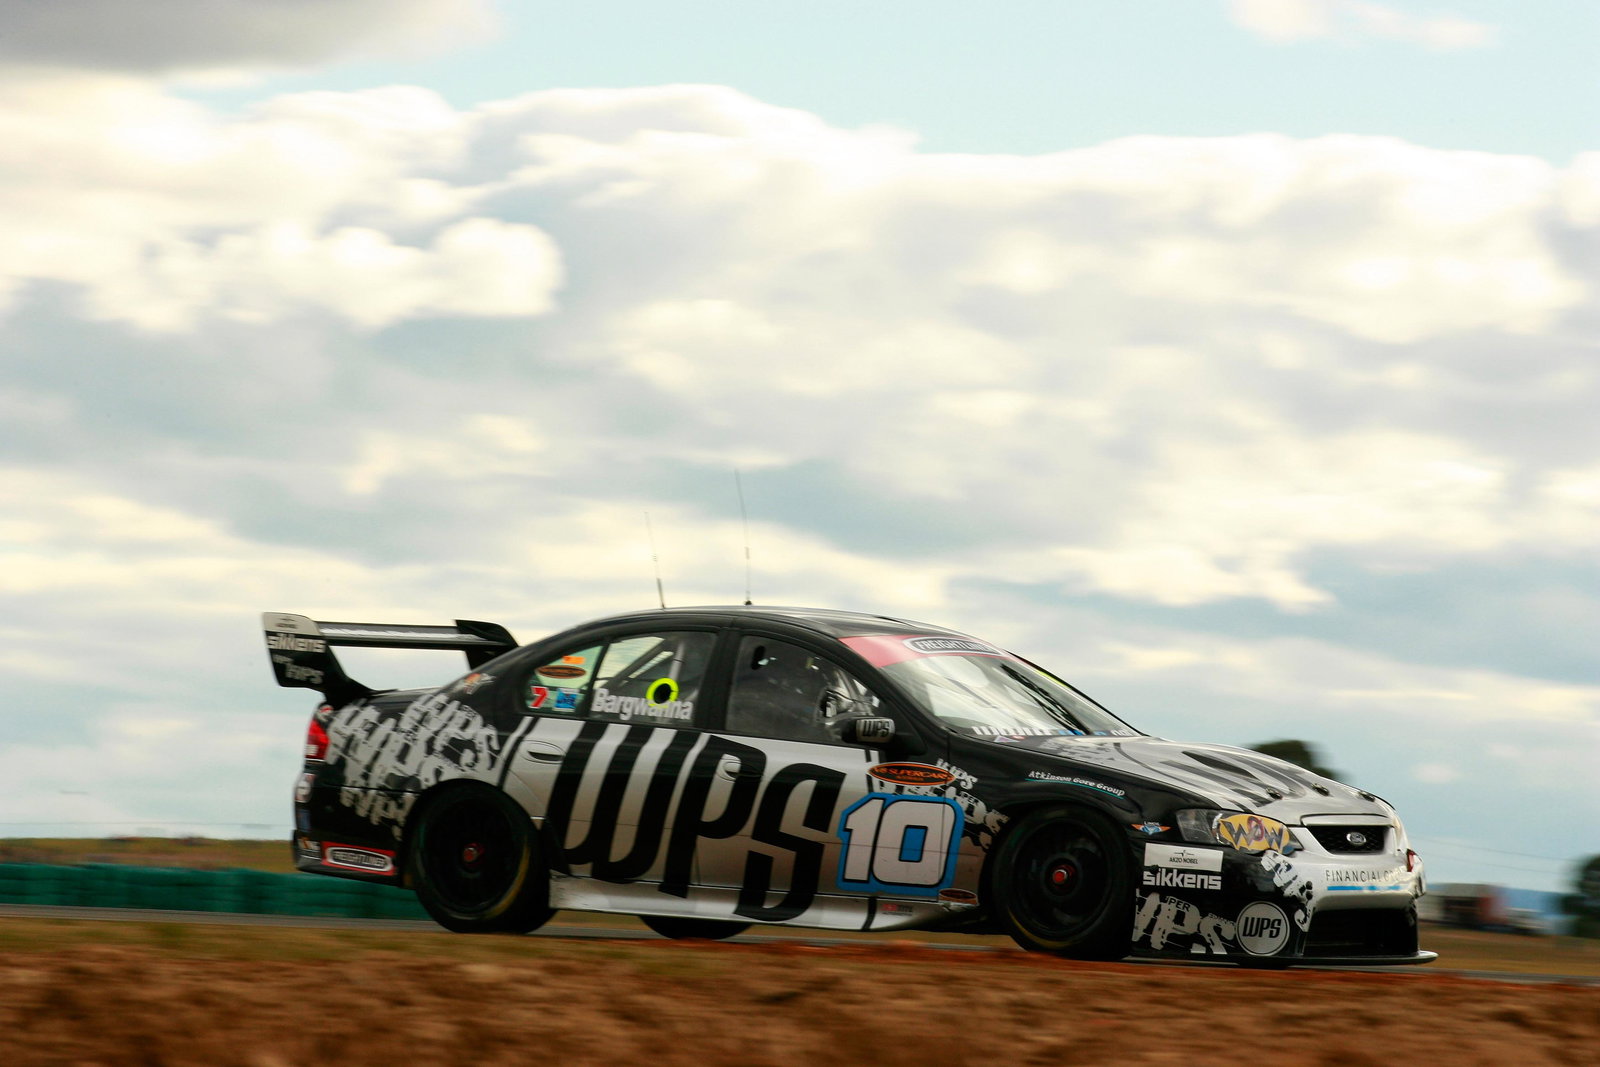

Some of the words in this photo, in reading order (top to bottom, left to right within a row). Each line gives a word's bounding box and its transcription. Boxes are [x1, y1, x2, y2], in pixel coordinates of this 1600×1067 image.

[529, 686, 548, 708] 7
[861, 720, 890, 738] WPS
[1028, 770, 1072, 782] Atkinson
[1072, 777, 1096, 787] Gore
[1096, 783, 1126, 797] Group
[545, 718, 846, 921] WPS
[844, 797, 956, 888] 10
[1219, 816, 1284, 852] WOW
[1143, 868, 1222, 890] sikkens
[1325, 870, 1382, 882] FINANCIAL
[1242, 917, 1282, 939] WPS
